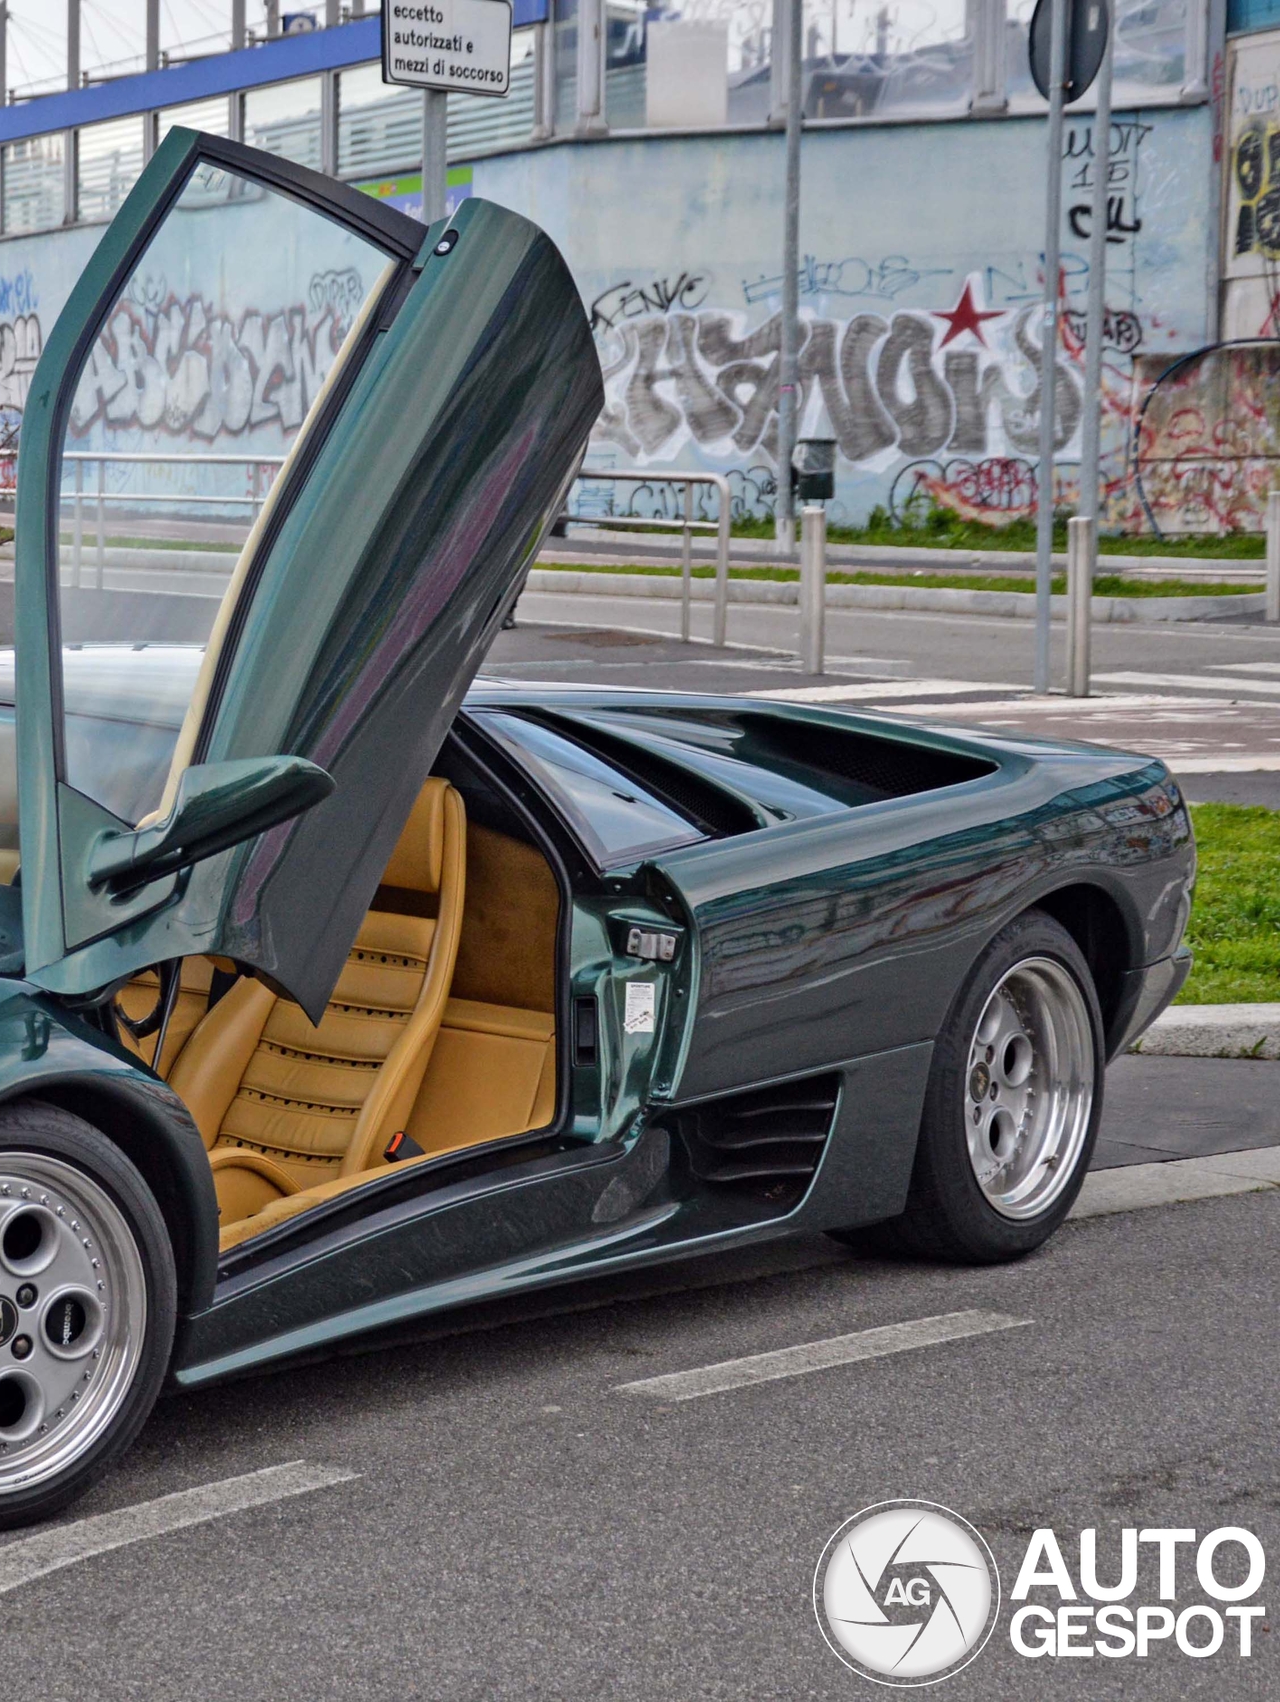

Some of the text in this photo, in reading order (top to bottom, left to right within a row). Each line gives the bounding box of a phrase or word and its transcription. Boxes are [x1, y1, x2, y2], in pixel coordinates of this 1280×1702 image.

[394, 5, 443, 23] eccetto
[394, 29, 474, 53] autorizzati e
[394, 57, 503, 83] mezzi di soccorso
